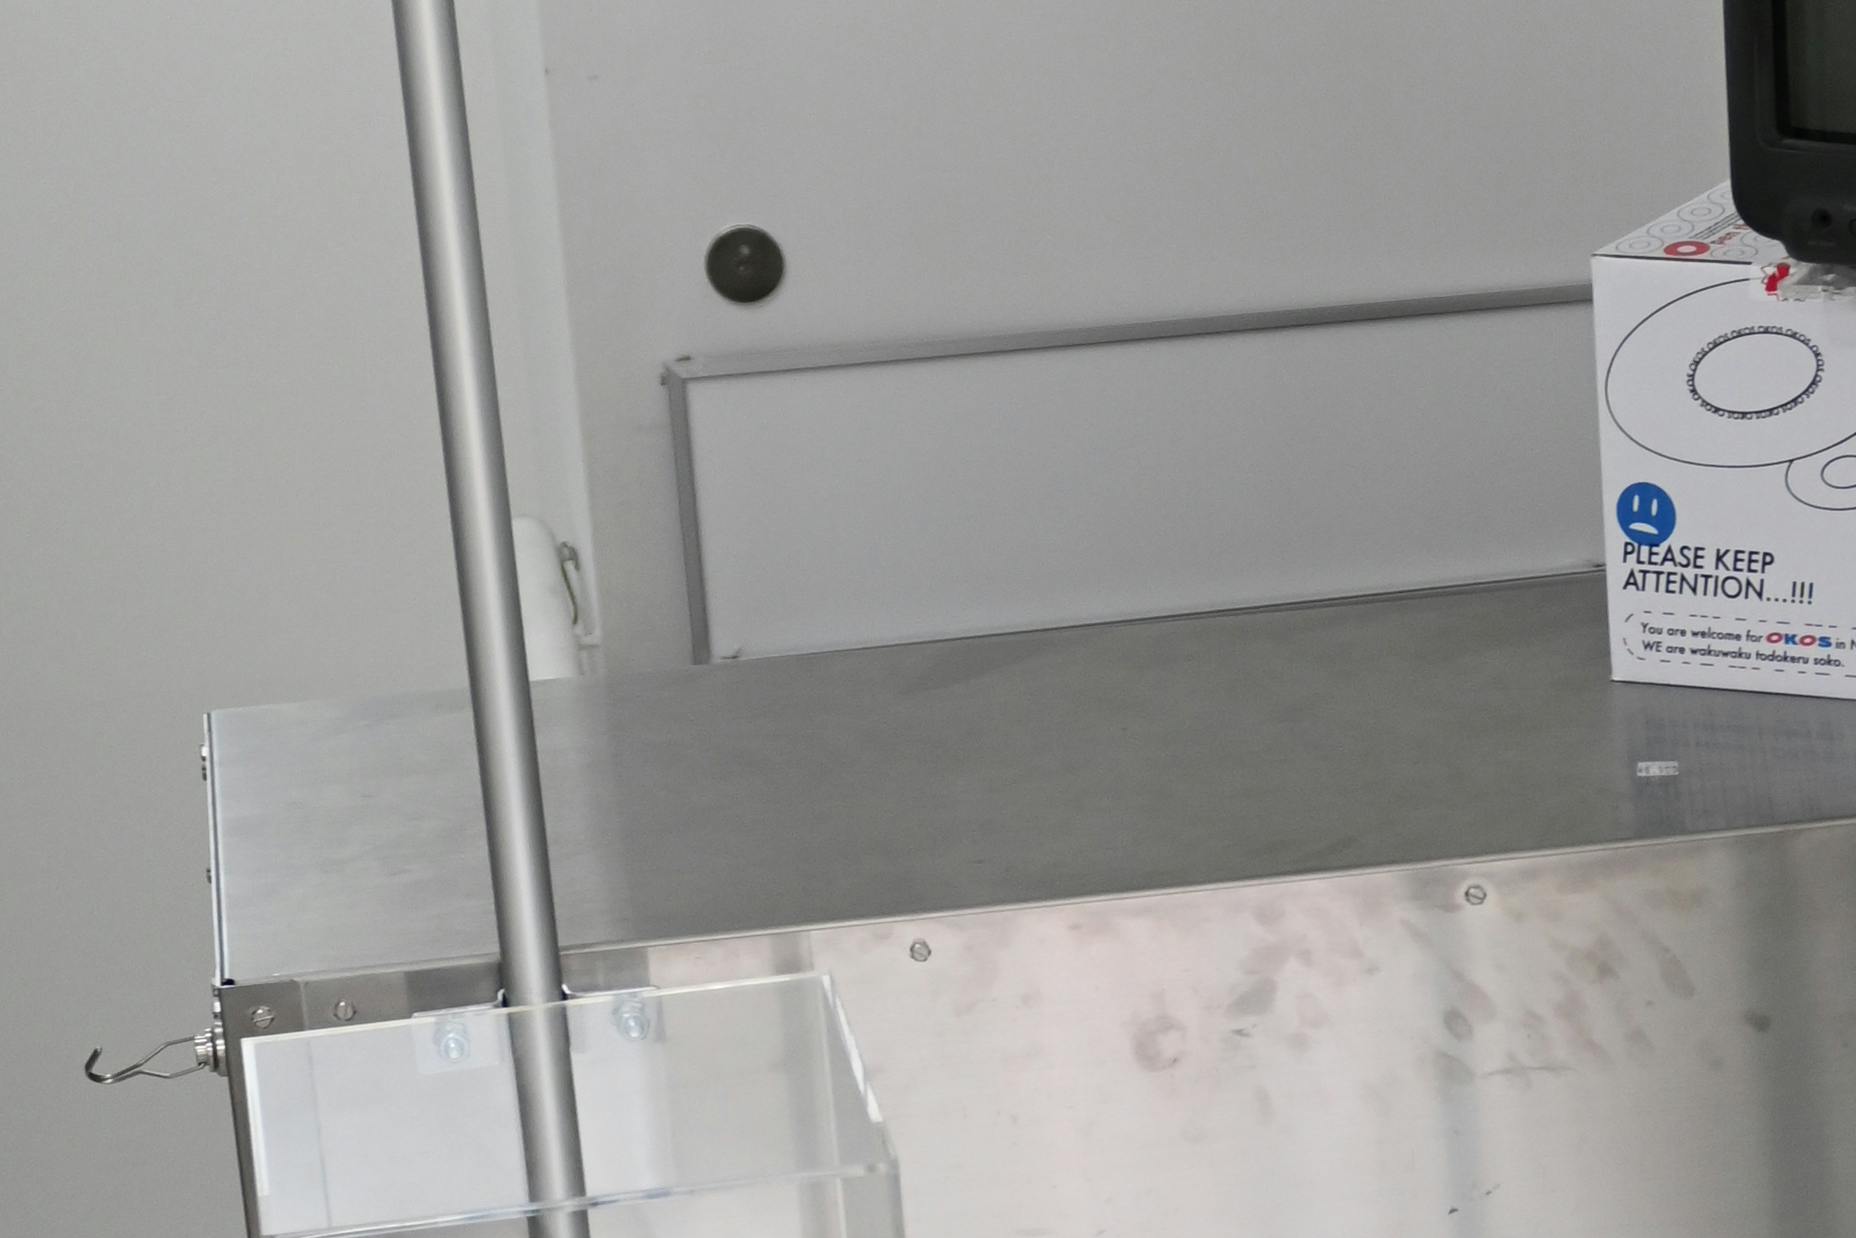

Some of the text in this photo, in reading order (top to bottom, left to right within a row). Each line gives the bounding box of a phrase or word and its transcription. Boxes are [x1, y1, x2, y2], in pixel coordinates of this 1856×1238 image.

[1622, 541, 1775, 574] PLEASE KEEP
[1622, 568, 1814, 605] ATTENTION...!!!
[1641, 621, 1663, 636] You
[1666, 627, 1687, 638] are
[1691, 627, 1742, 643] welcome
[1746, 629, 1764, 643] for
[1766, 632, 1833, 648] OKOS
[1835, 638, 1846, 650] in
[1641, 640, 1663, 652] WE
[1666, 643, 1687, 655] are
[1690, 643, 1752, 660] wakuwaku
[1755, 650, 1809, 665] todokeru
